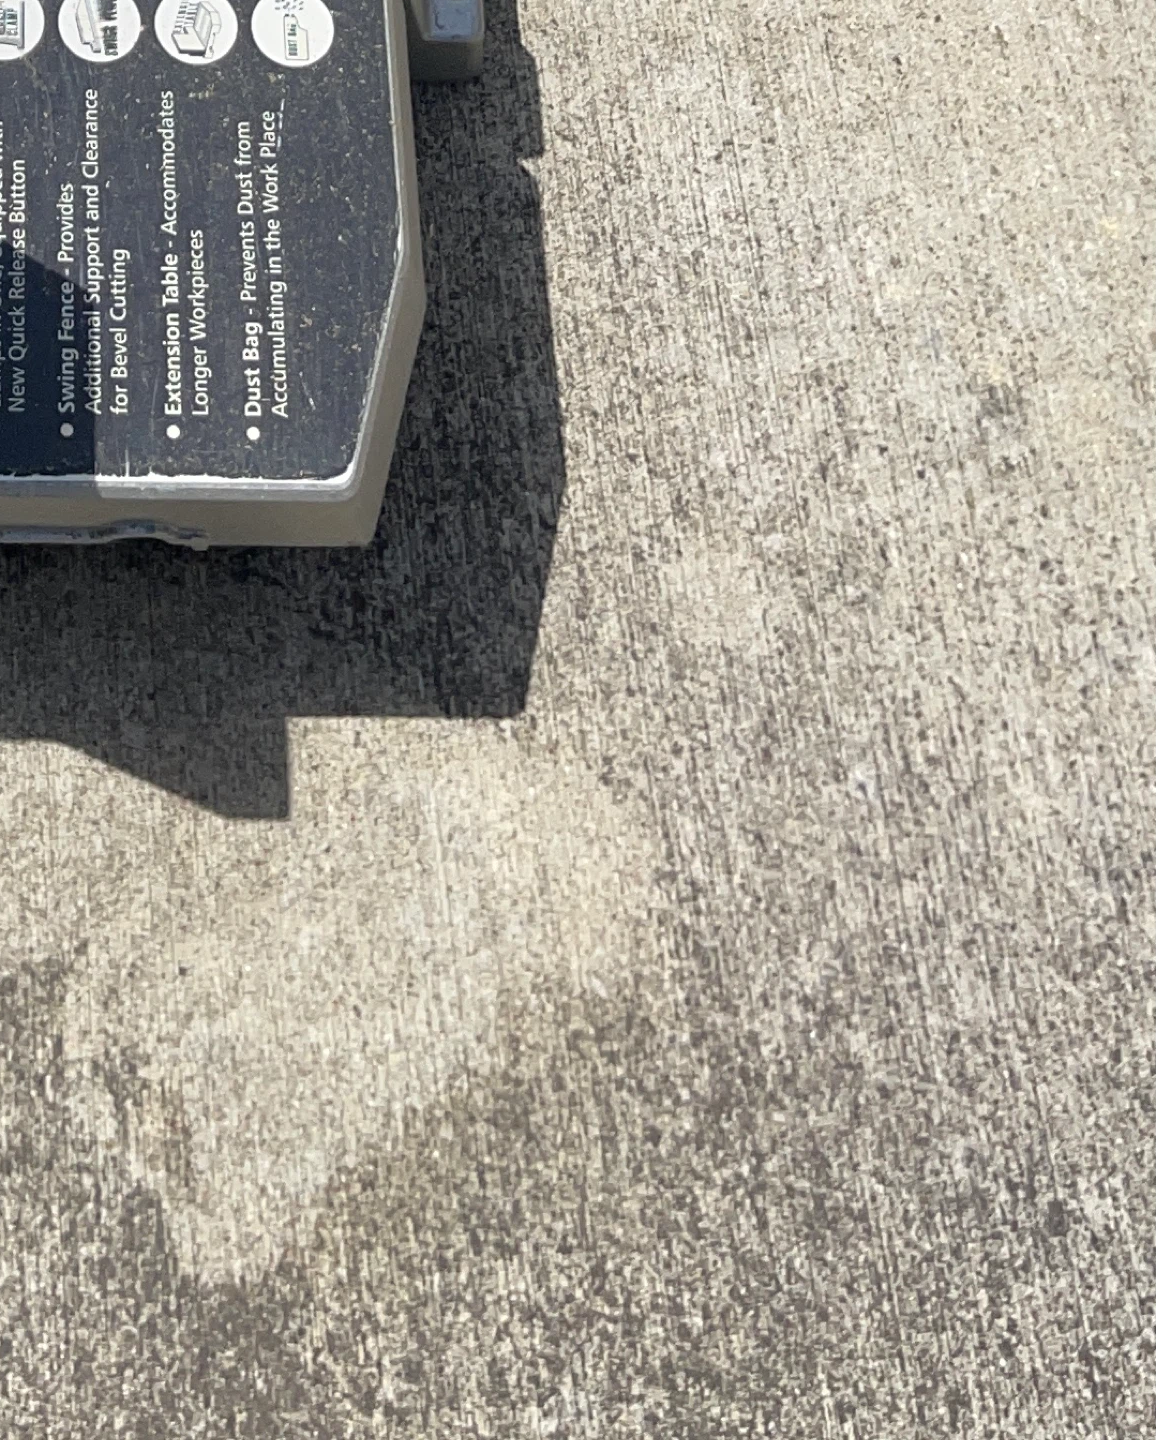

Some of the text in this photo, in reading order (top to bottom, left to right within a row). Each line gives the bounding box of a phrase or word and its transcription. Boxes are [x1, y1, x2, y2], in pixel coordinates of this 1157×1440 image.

[158, 91, 177, 235] Accommodates
[234, 122, 251, 165] from
[57, 184, 74, 262] Provides
[235, 172, 253, 215] Dust
[8, 160, 28, 412] New Quick Release Button
[81, 89, 104, 415] Additional Support and Clearance
[160, 254, 180, 307] Table
[239, 221, 257, 301] Prevents
[259, 111, 289, 418] Accumulating in the Work Place
[58, 282, 74, 340] Fence
[108, 249, 130, 415] for Bevel Cutting
[187, 229, 212, 415] Longer Workpieces
[242, 322, 263, 360] Bag
[58, 348, 79, 413] Swing
[163, 313, 182, 415] Extension
[244, 368, 261, 417] Dust
